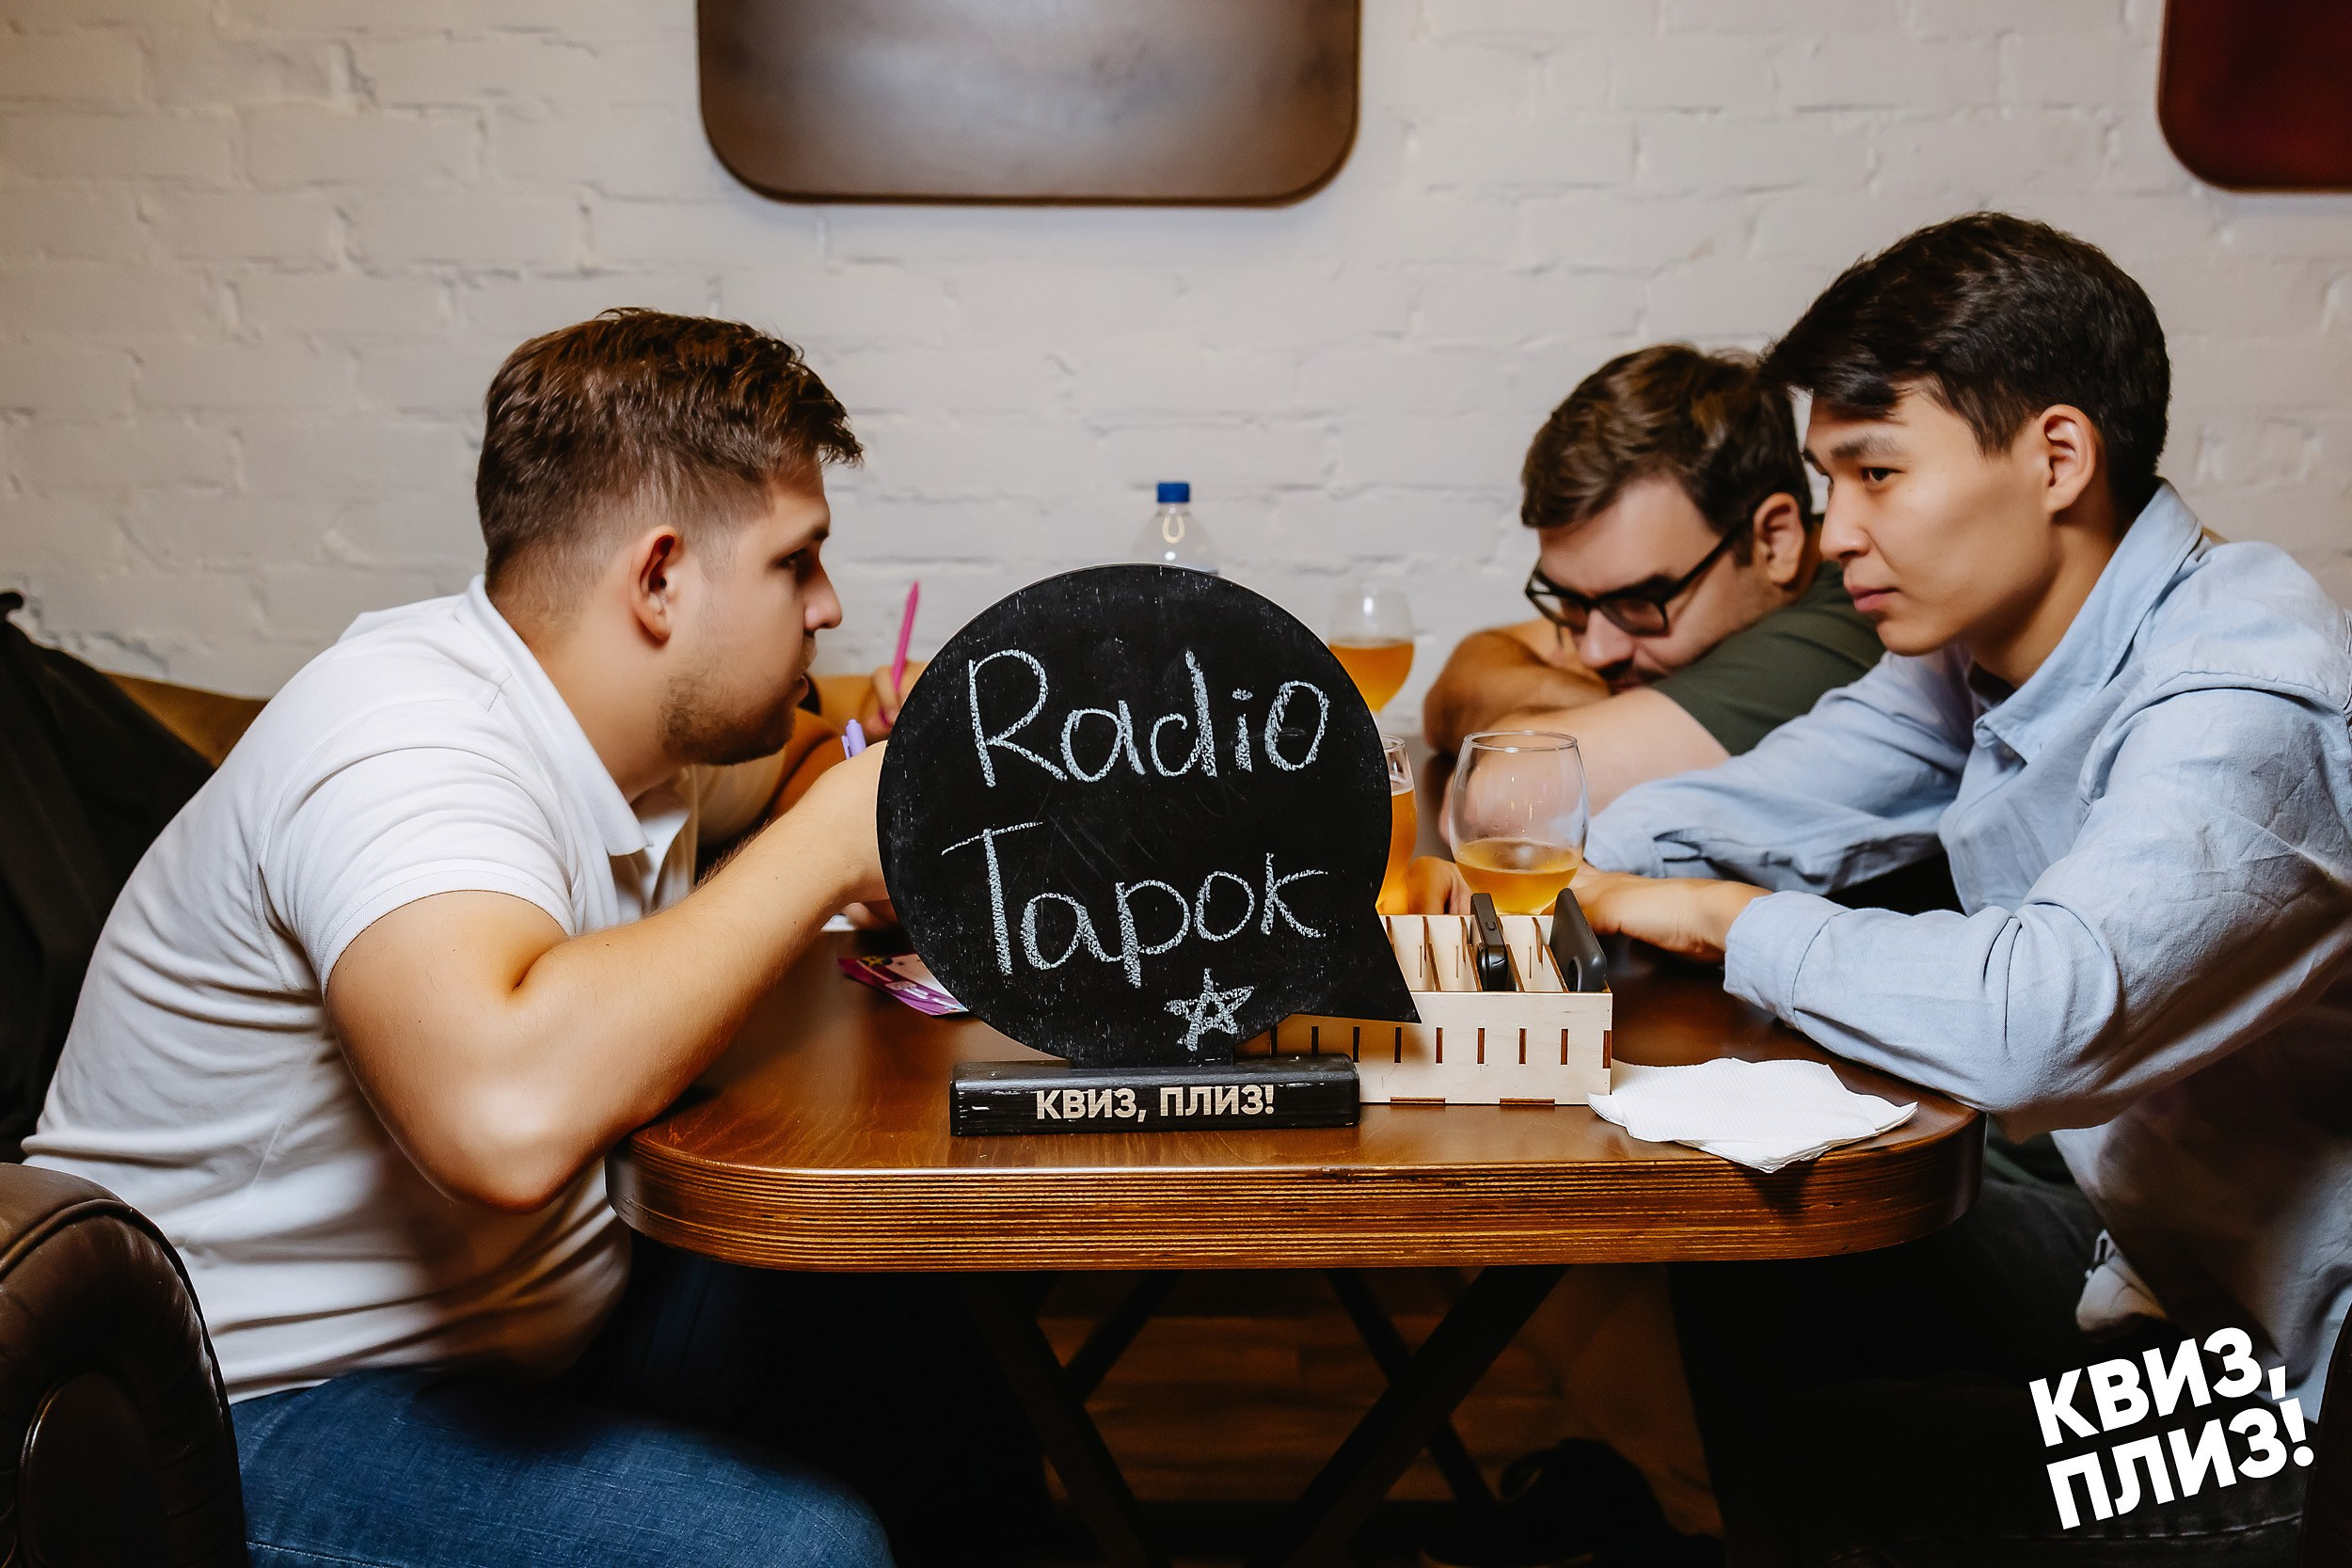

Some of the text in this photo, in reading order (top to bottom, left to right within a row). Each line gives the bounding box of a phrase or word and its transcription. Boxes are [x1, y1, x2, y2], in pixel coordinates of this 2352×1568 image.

[968, 648, 1329, 788] Radio
[941, 821, 1328, 989] Tapok
[1036, 1085, 1275, 1123] КВИЗ, ПЛИЗ!
